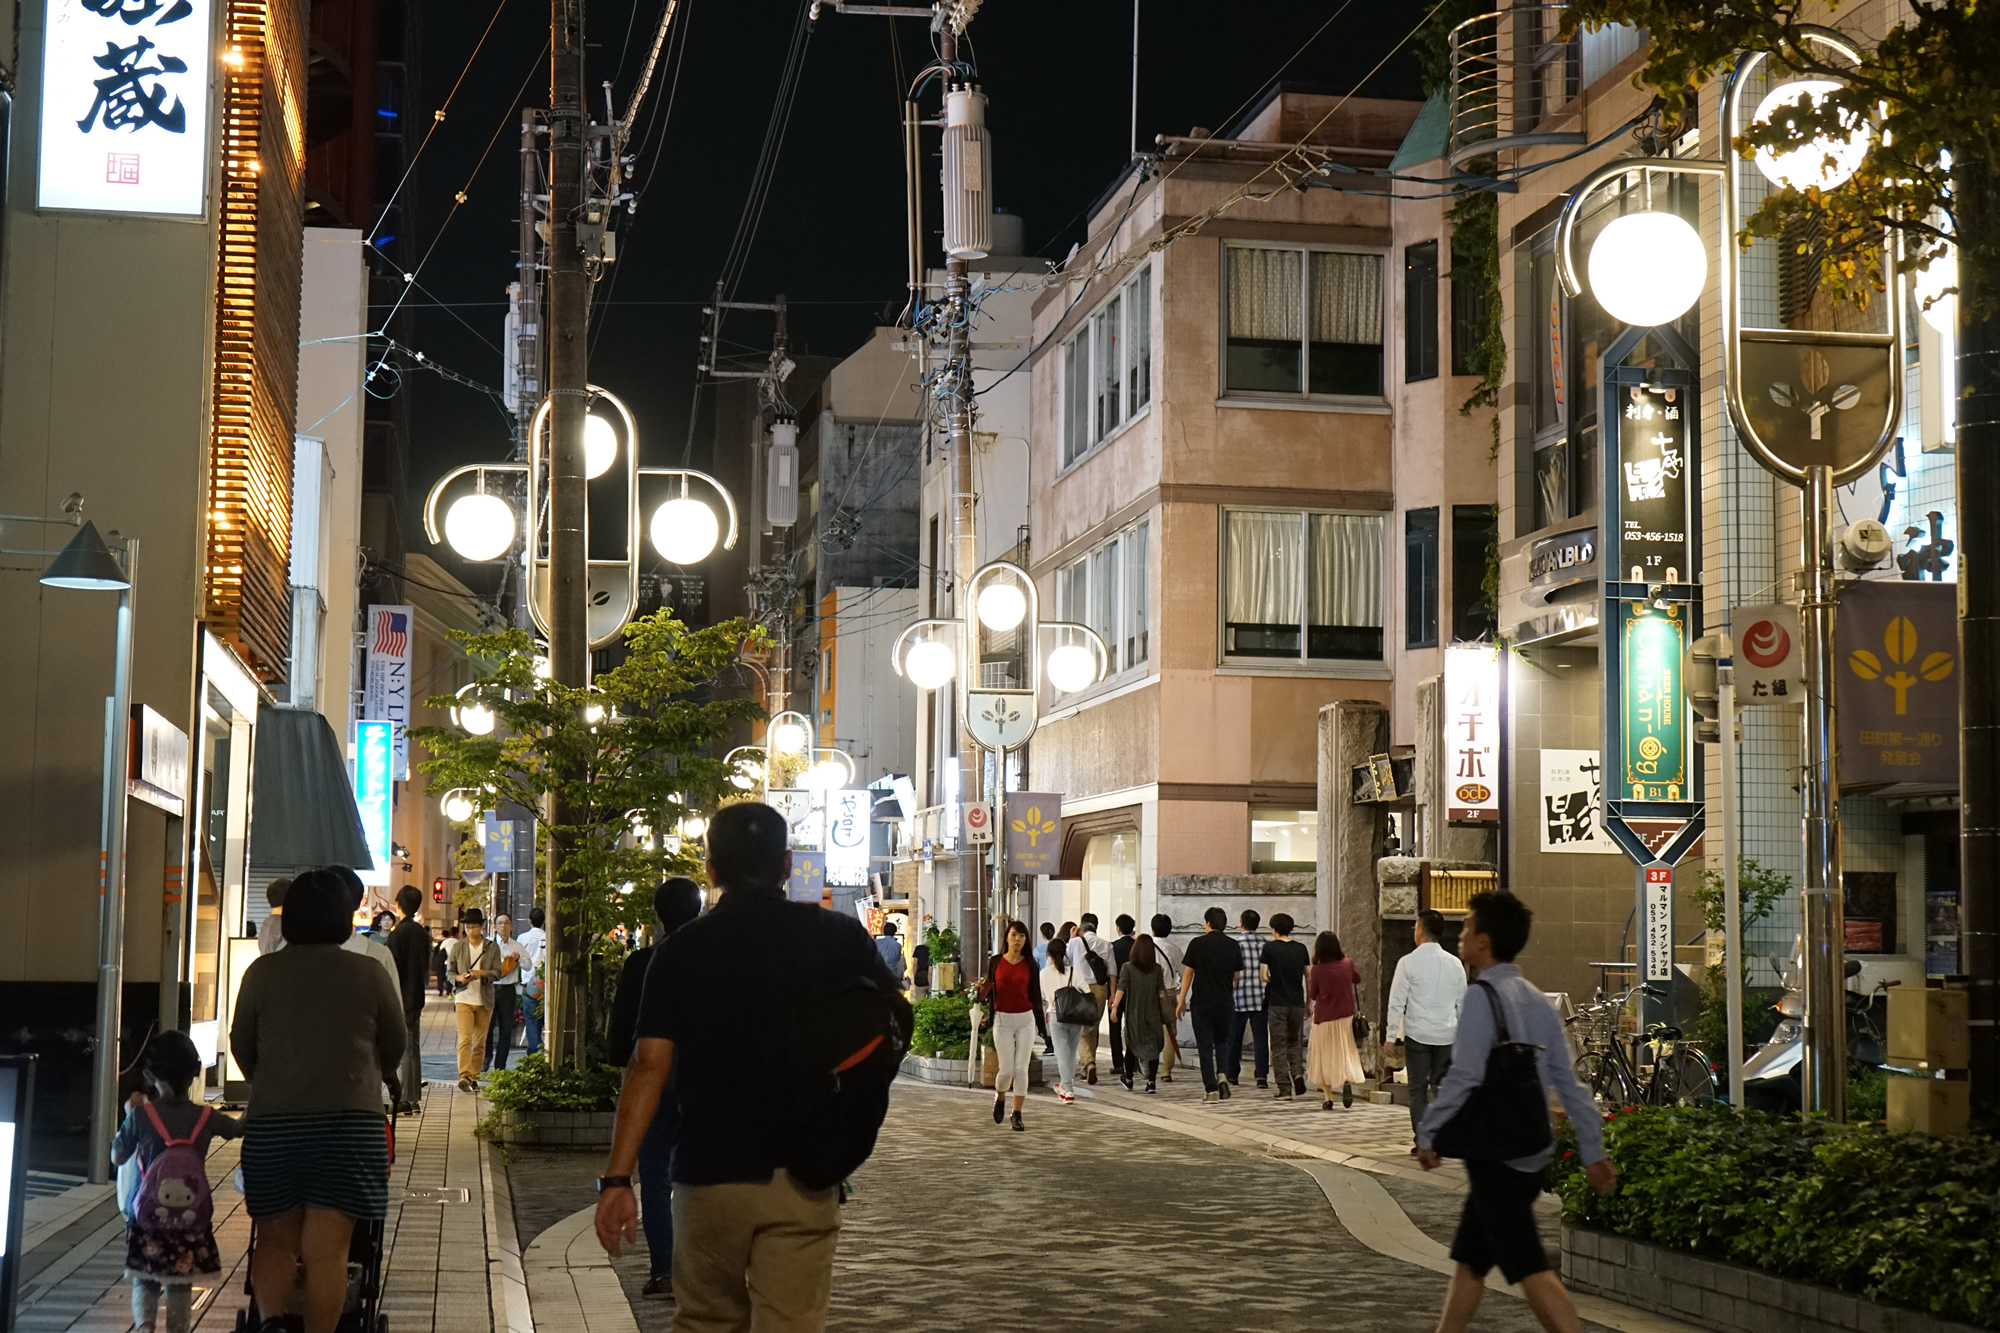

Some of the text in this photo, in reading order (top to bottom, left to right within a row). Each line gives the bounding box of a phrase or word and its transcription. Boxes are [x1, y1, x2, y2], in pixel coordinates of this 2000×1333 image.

[1625, 521, 1641, 529] TEL.
[1624, 532, 1684, 542] 053-456-1518
[1646, 556, 1662, 566] 1F
[1752, 679, 1788, 697] た組
[1663, 669, 1671, 725] BEER HOUSE
[1860, 731, 1942, 746] 田町第一通り
[1880, 751, 1921, 765] 発展会
[1459, 784, 1488, 800] ocb
[1649, 787, 1662, 797] B1
[1467, 810, 1480, 818] 2F
[1651, 871, 1667, 881] 3F
[1660, 885, 1668, 976] マルマン ワイシャツ店
